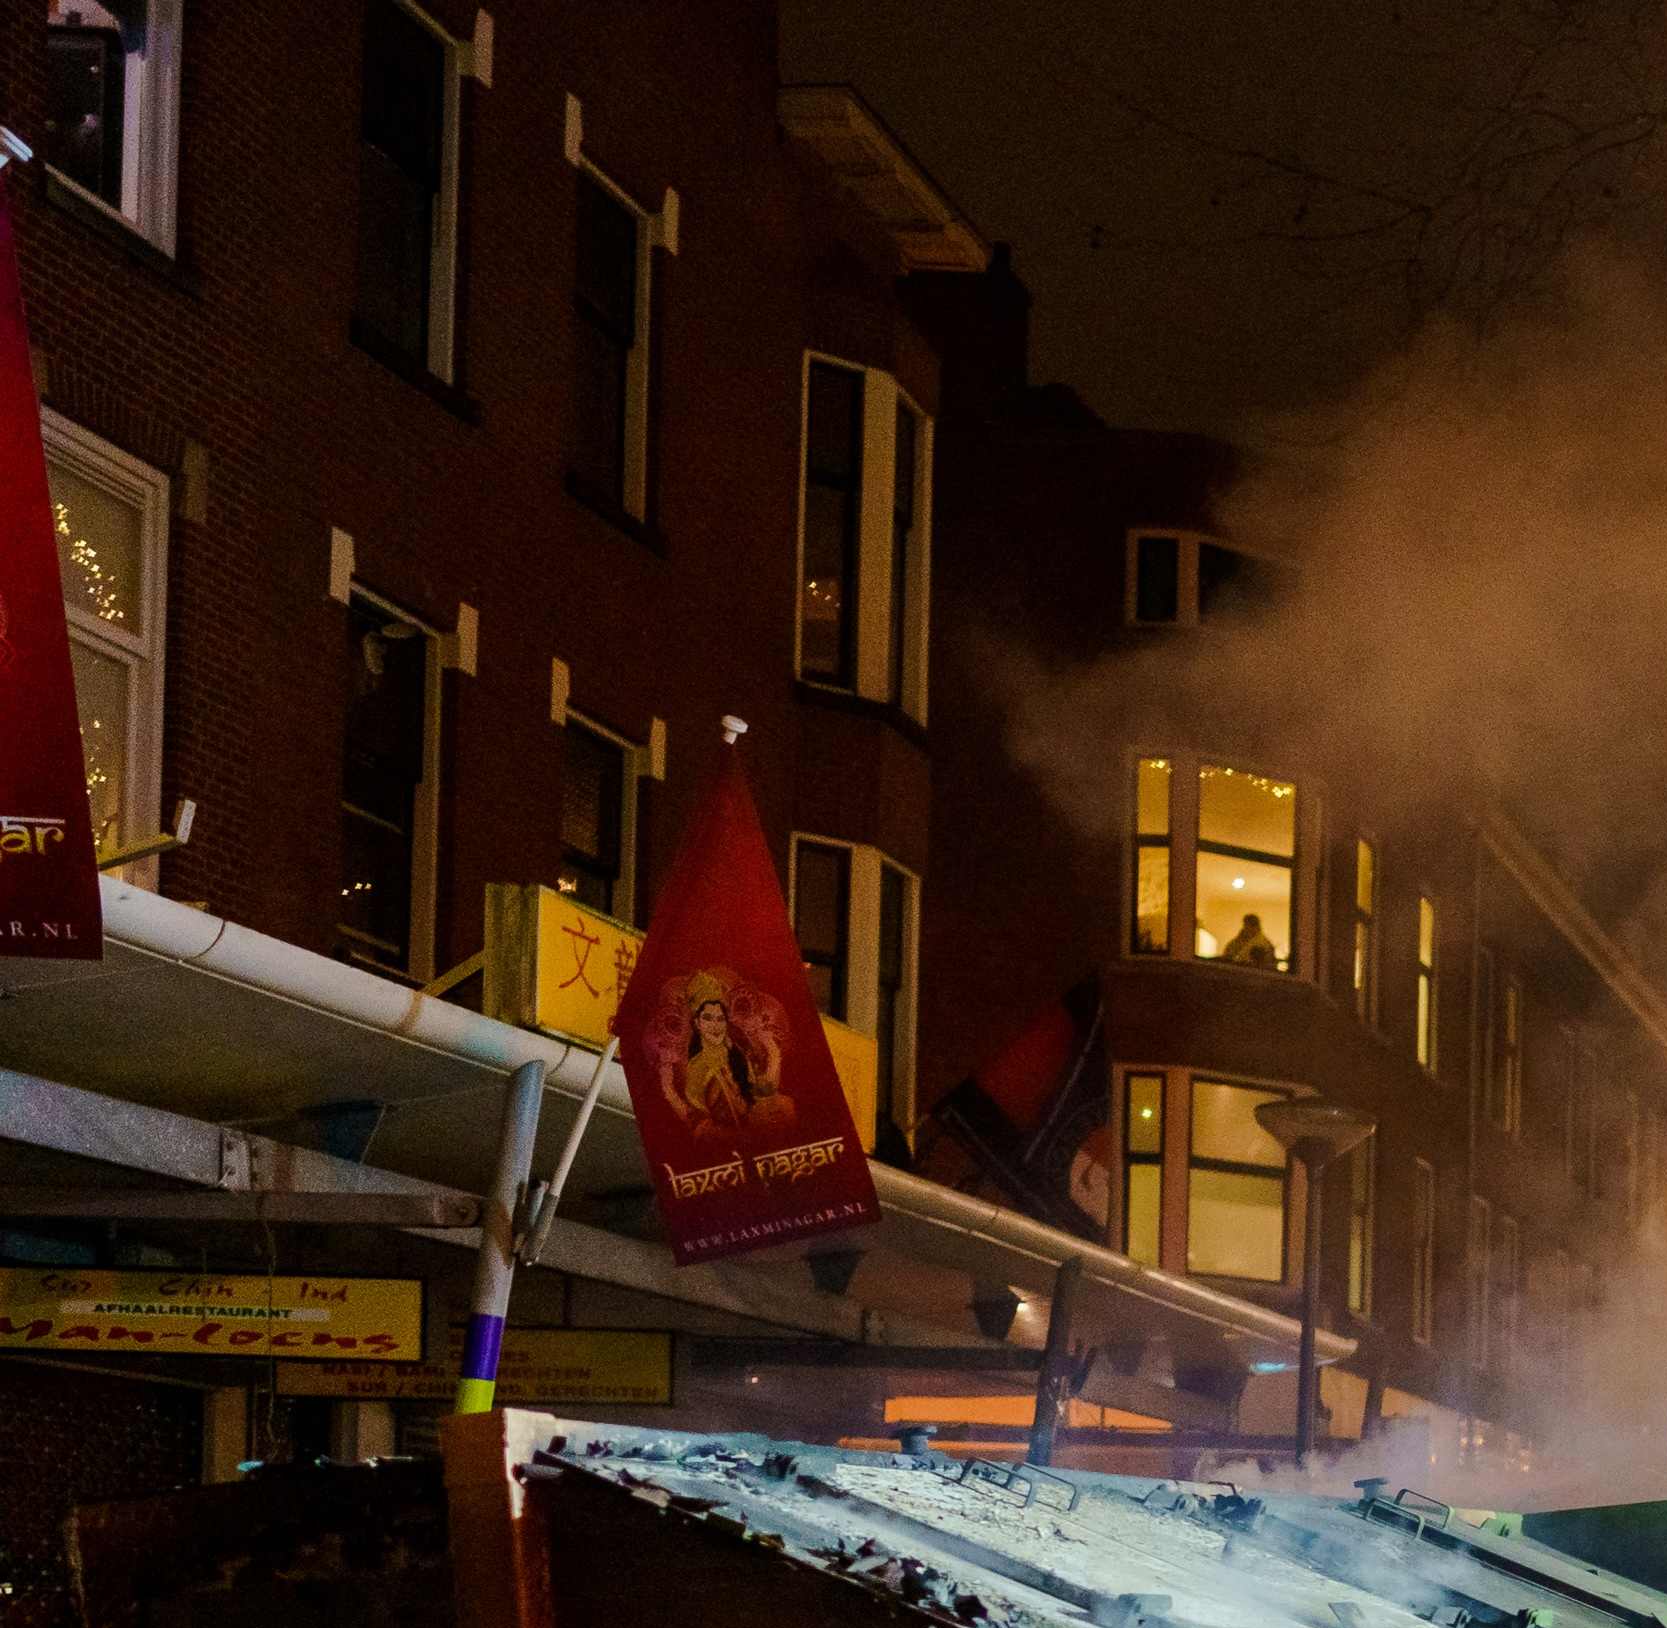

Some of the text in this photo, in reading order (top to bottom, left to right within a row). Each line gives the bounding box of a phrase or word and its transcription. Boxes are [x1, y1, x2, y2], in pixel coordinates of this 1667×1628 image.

[752, 1136, 844, 1184] nagar
[684, 1202, 867, 1252] WWW.LAXMINAGAR.NL
[94, 1303, 293, 1318] AFHAALRESTAURANT
